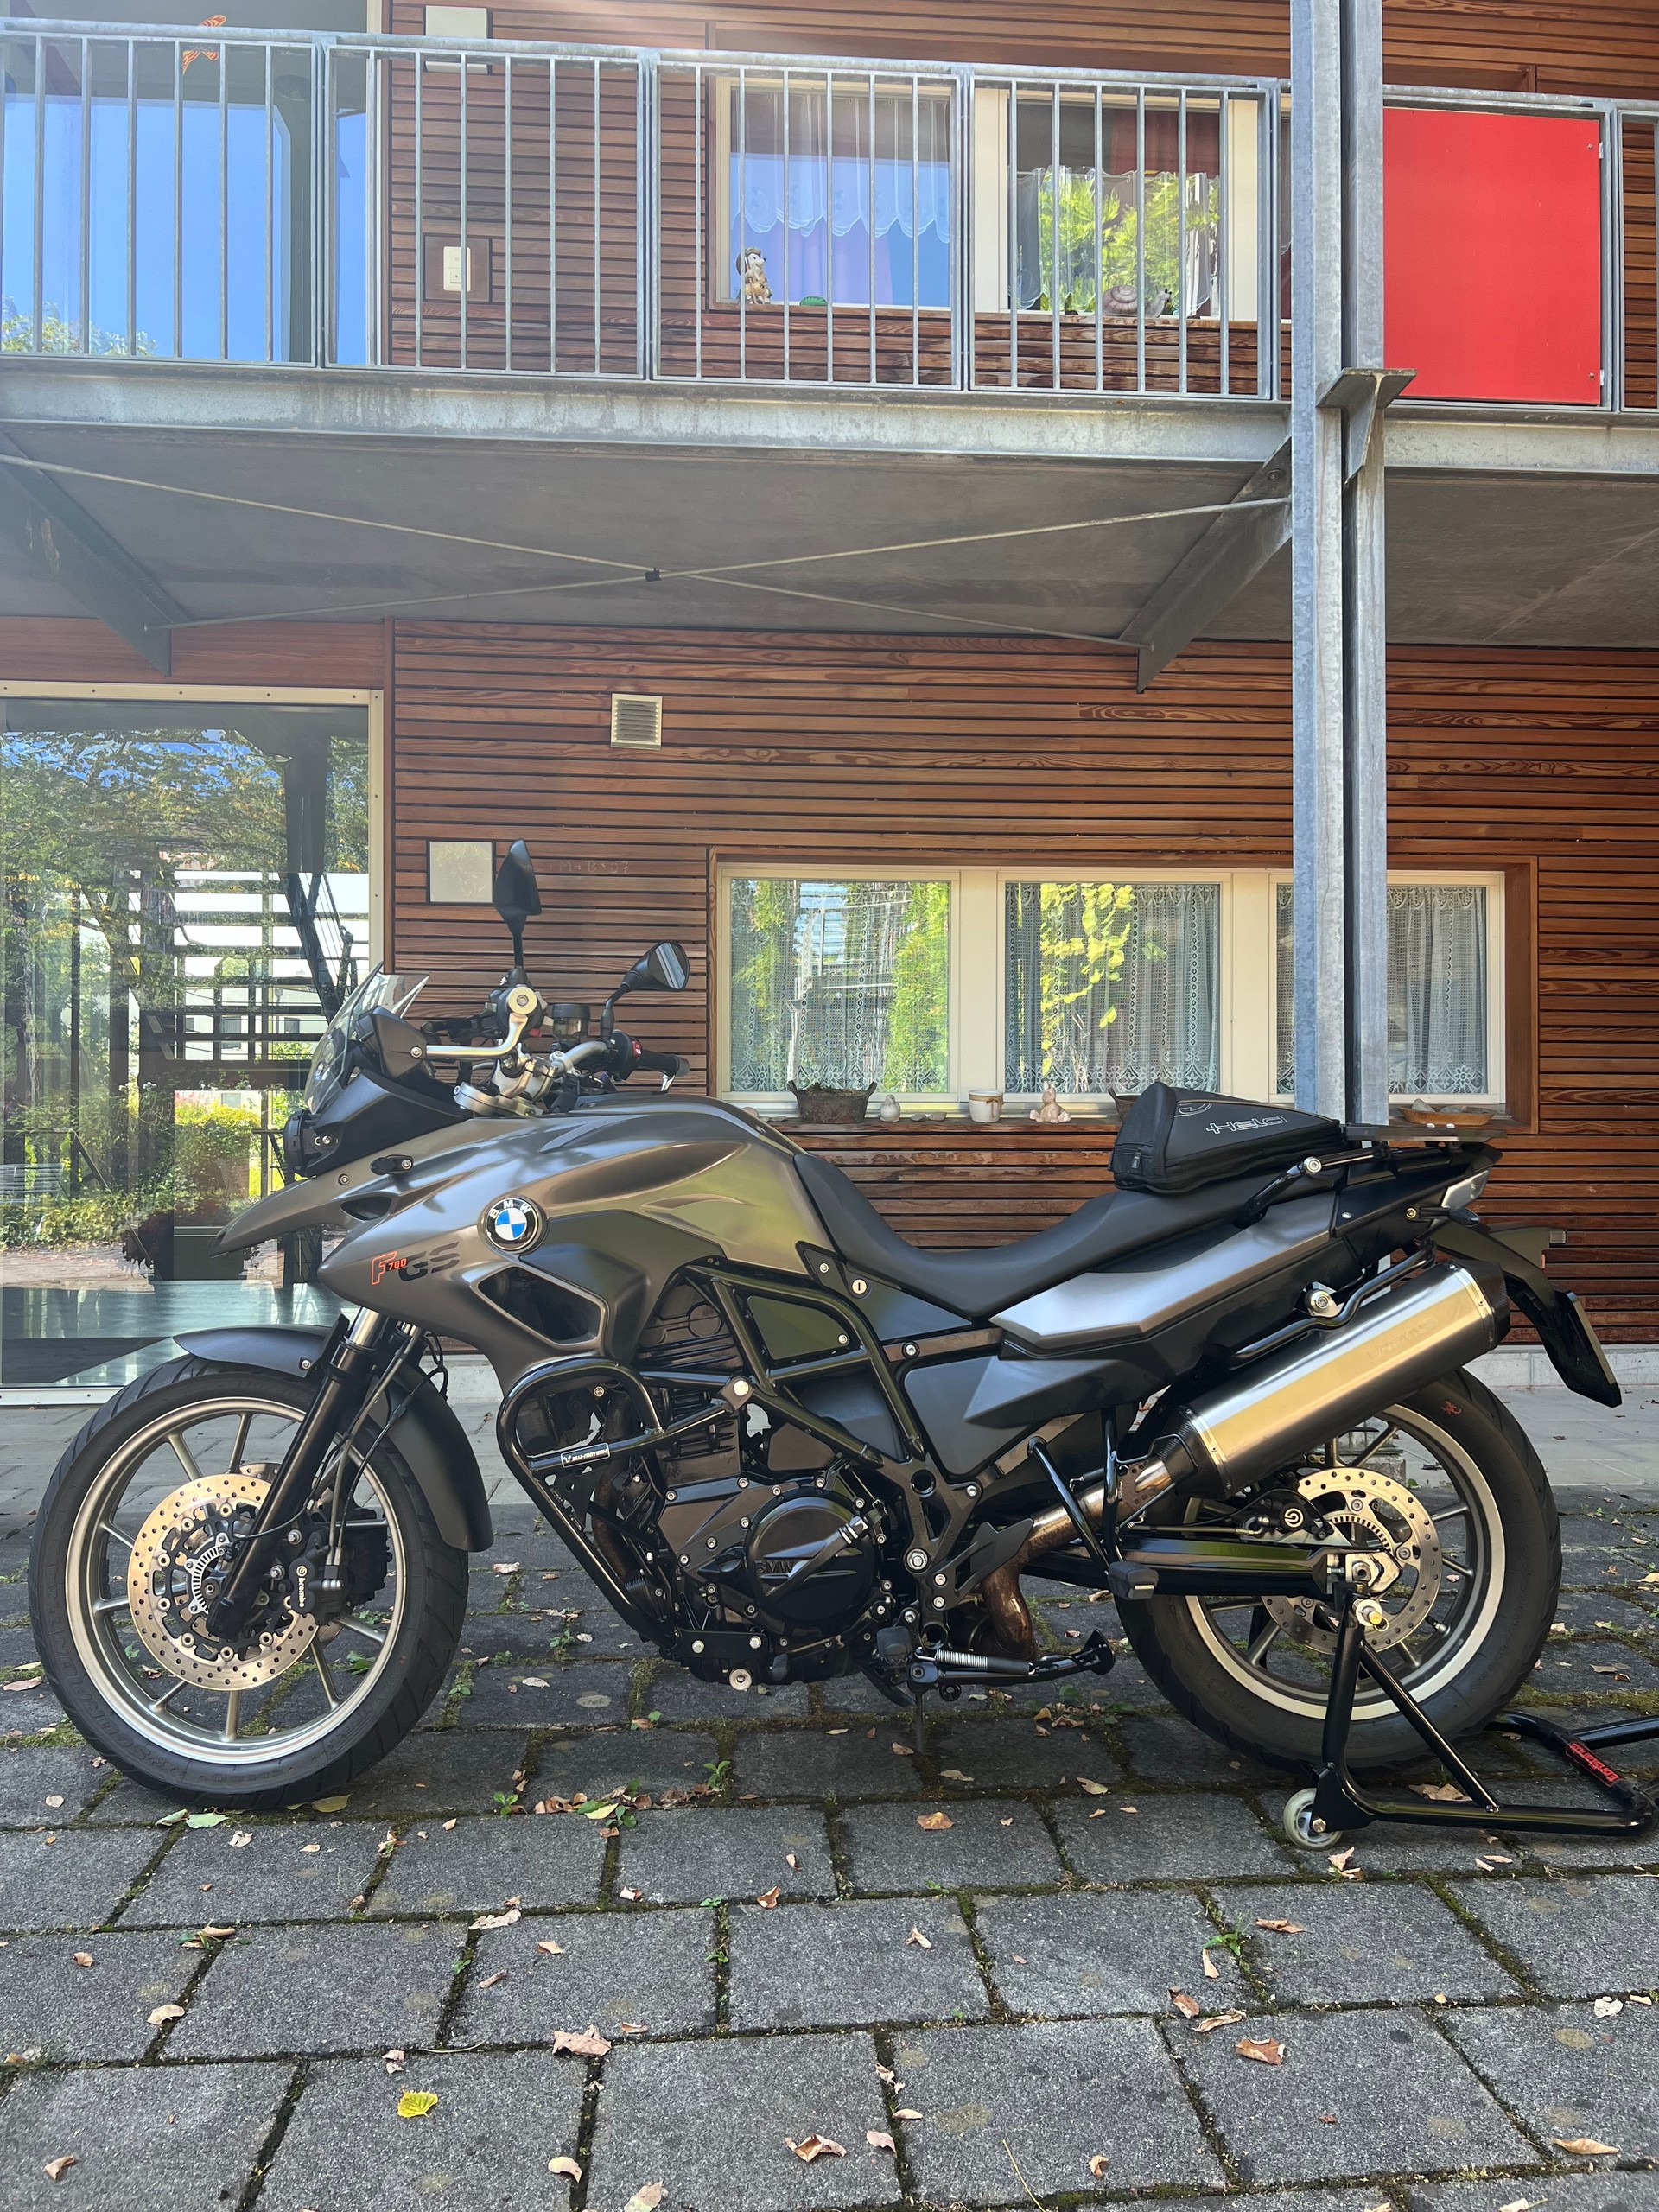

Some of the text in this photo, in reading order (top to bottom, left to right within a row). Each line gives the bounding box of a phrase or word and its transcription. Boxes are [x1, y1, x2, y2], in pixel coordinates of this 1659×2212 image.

[1205, 1115, 1289, 1135] Held
[488, 1198, 532, 1219] BMW
[371, 1242, 461, 1287] F 700 GS
[754, 1560, 794, 1574] BMW
[298, 1576, 308, 1608] brembo
